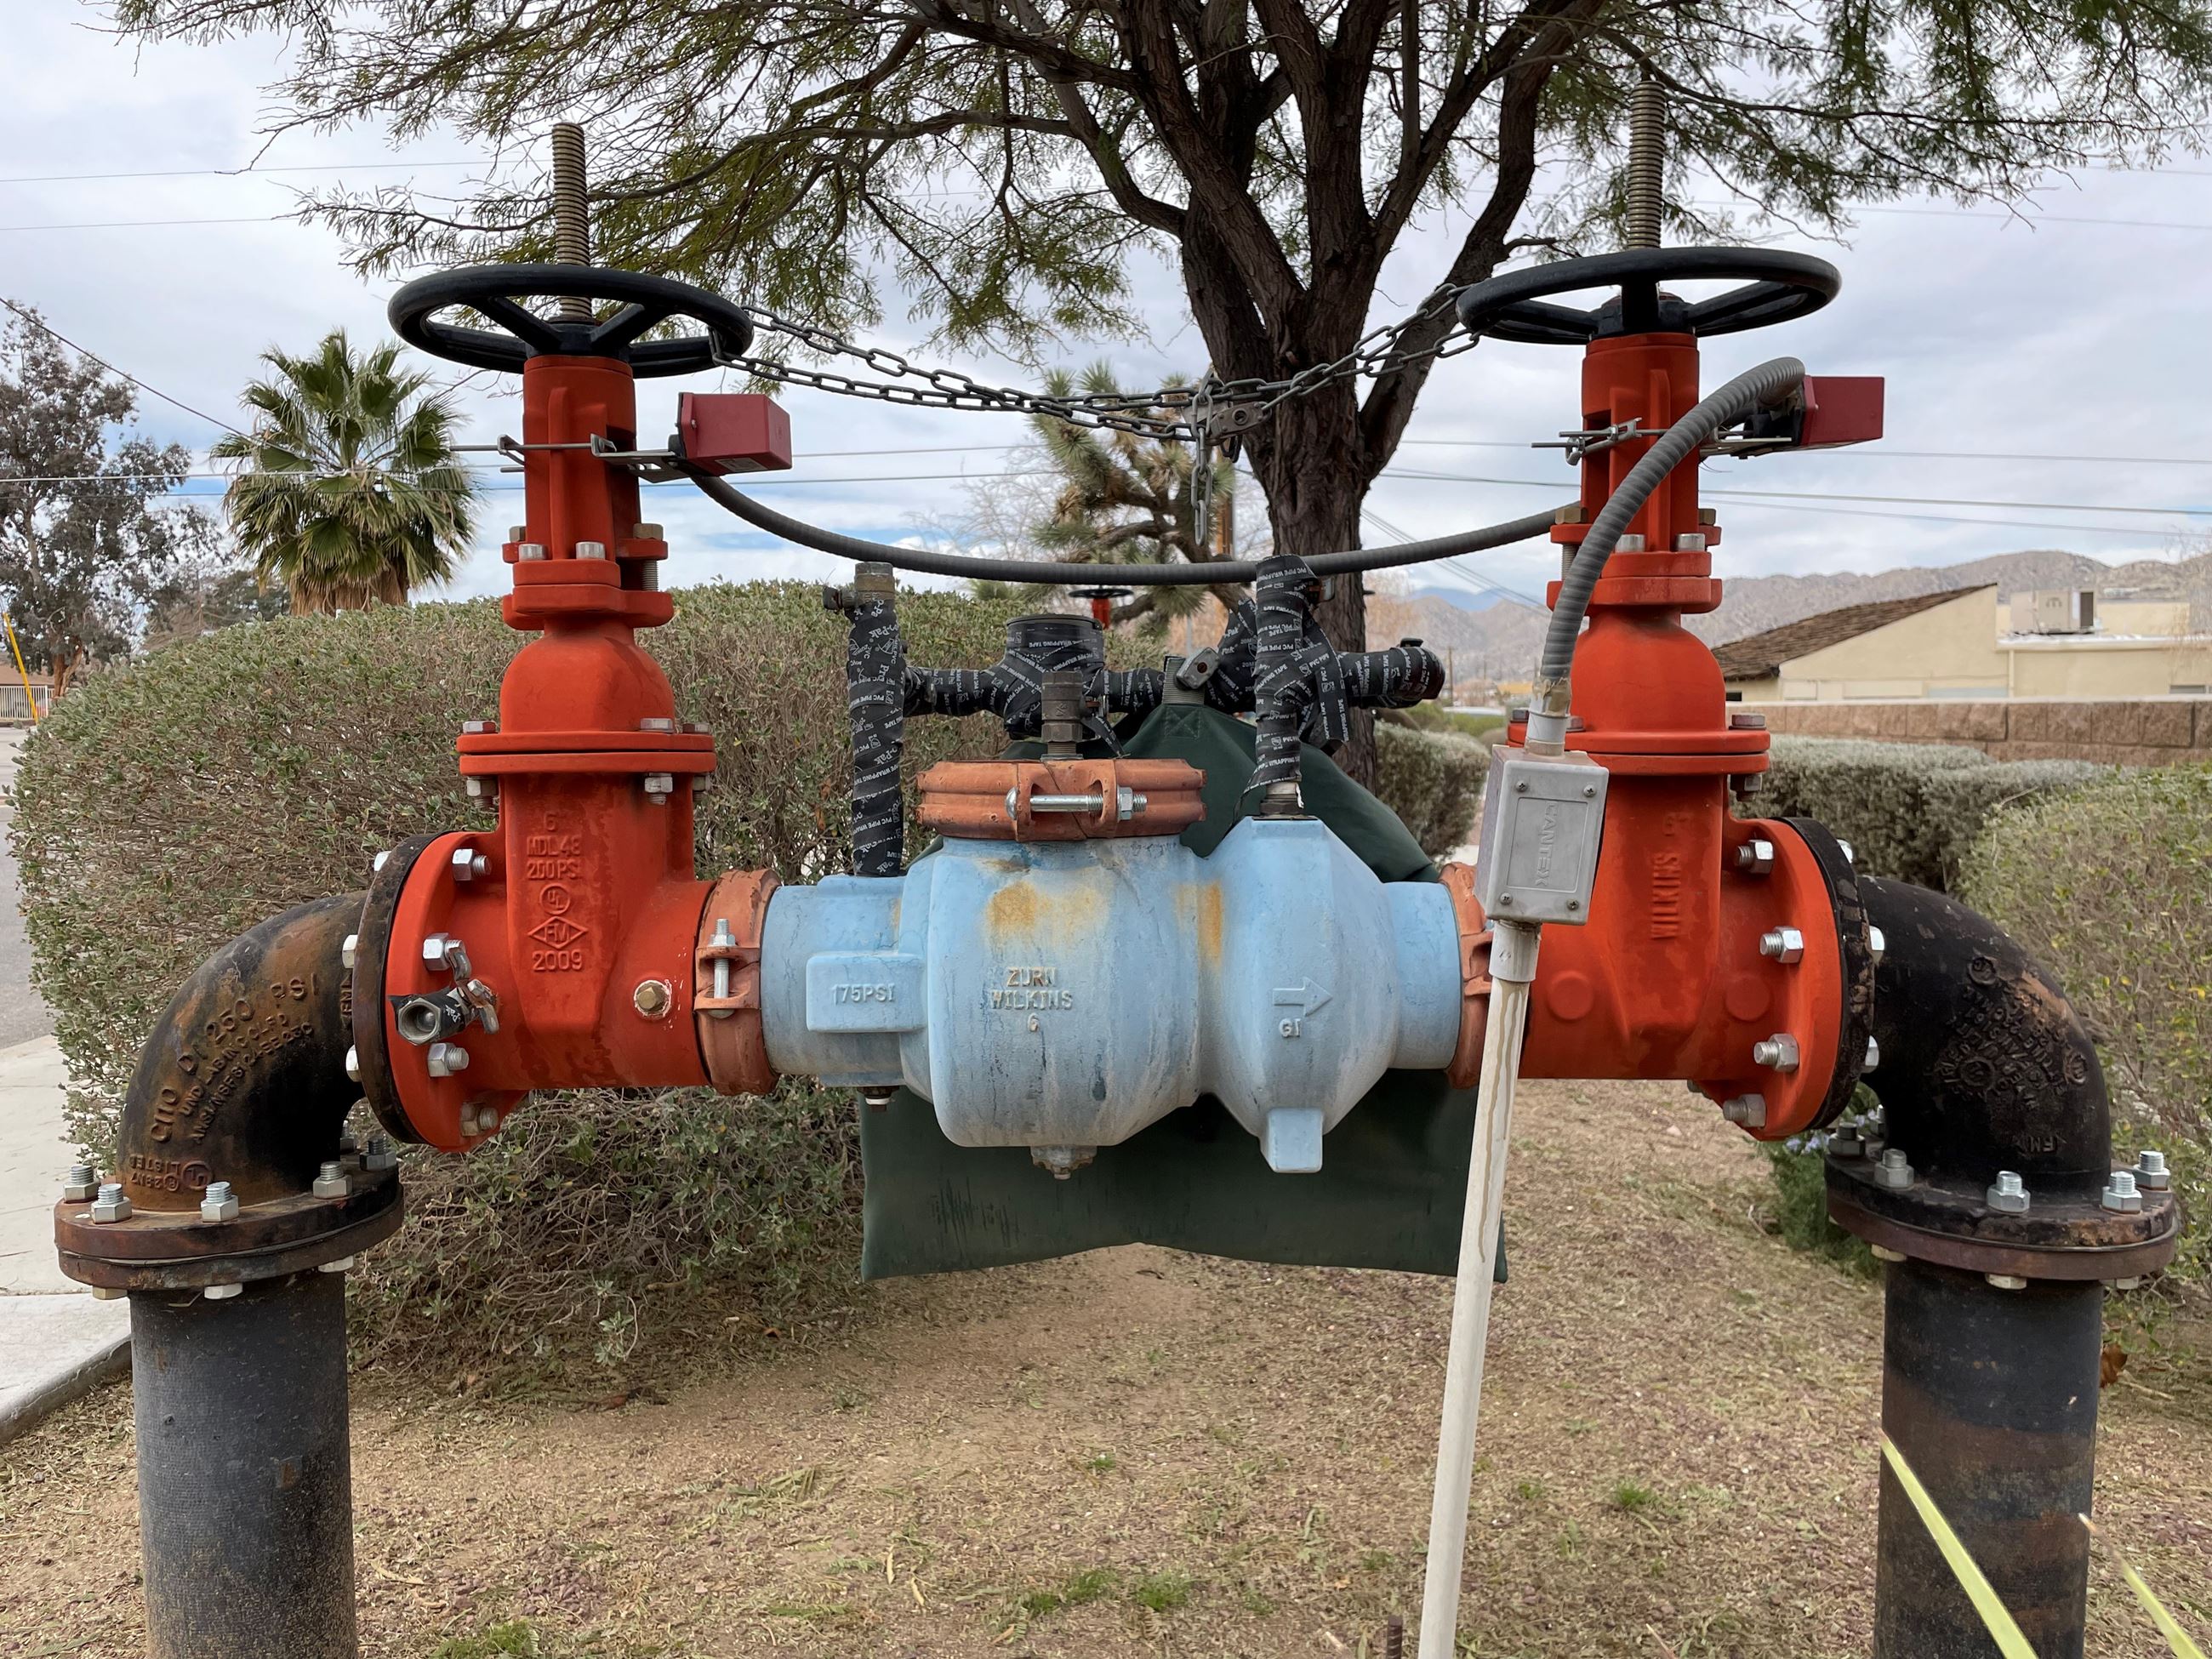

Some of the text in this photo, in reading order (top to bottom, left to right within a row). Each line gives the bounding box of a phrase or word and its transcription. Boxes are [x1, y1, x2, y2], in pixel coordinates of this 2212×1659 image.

[532, 949, 584, 972] 2009
[1006, 966, 1057, 987] ZURN
[990, 989, 1073, 1011] WILKINS
[129, 1154, 181, 1175] LISTED
